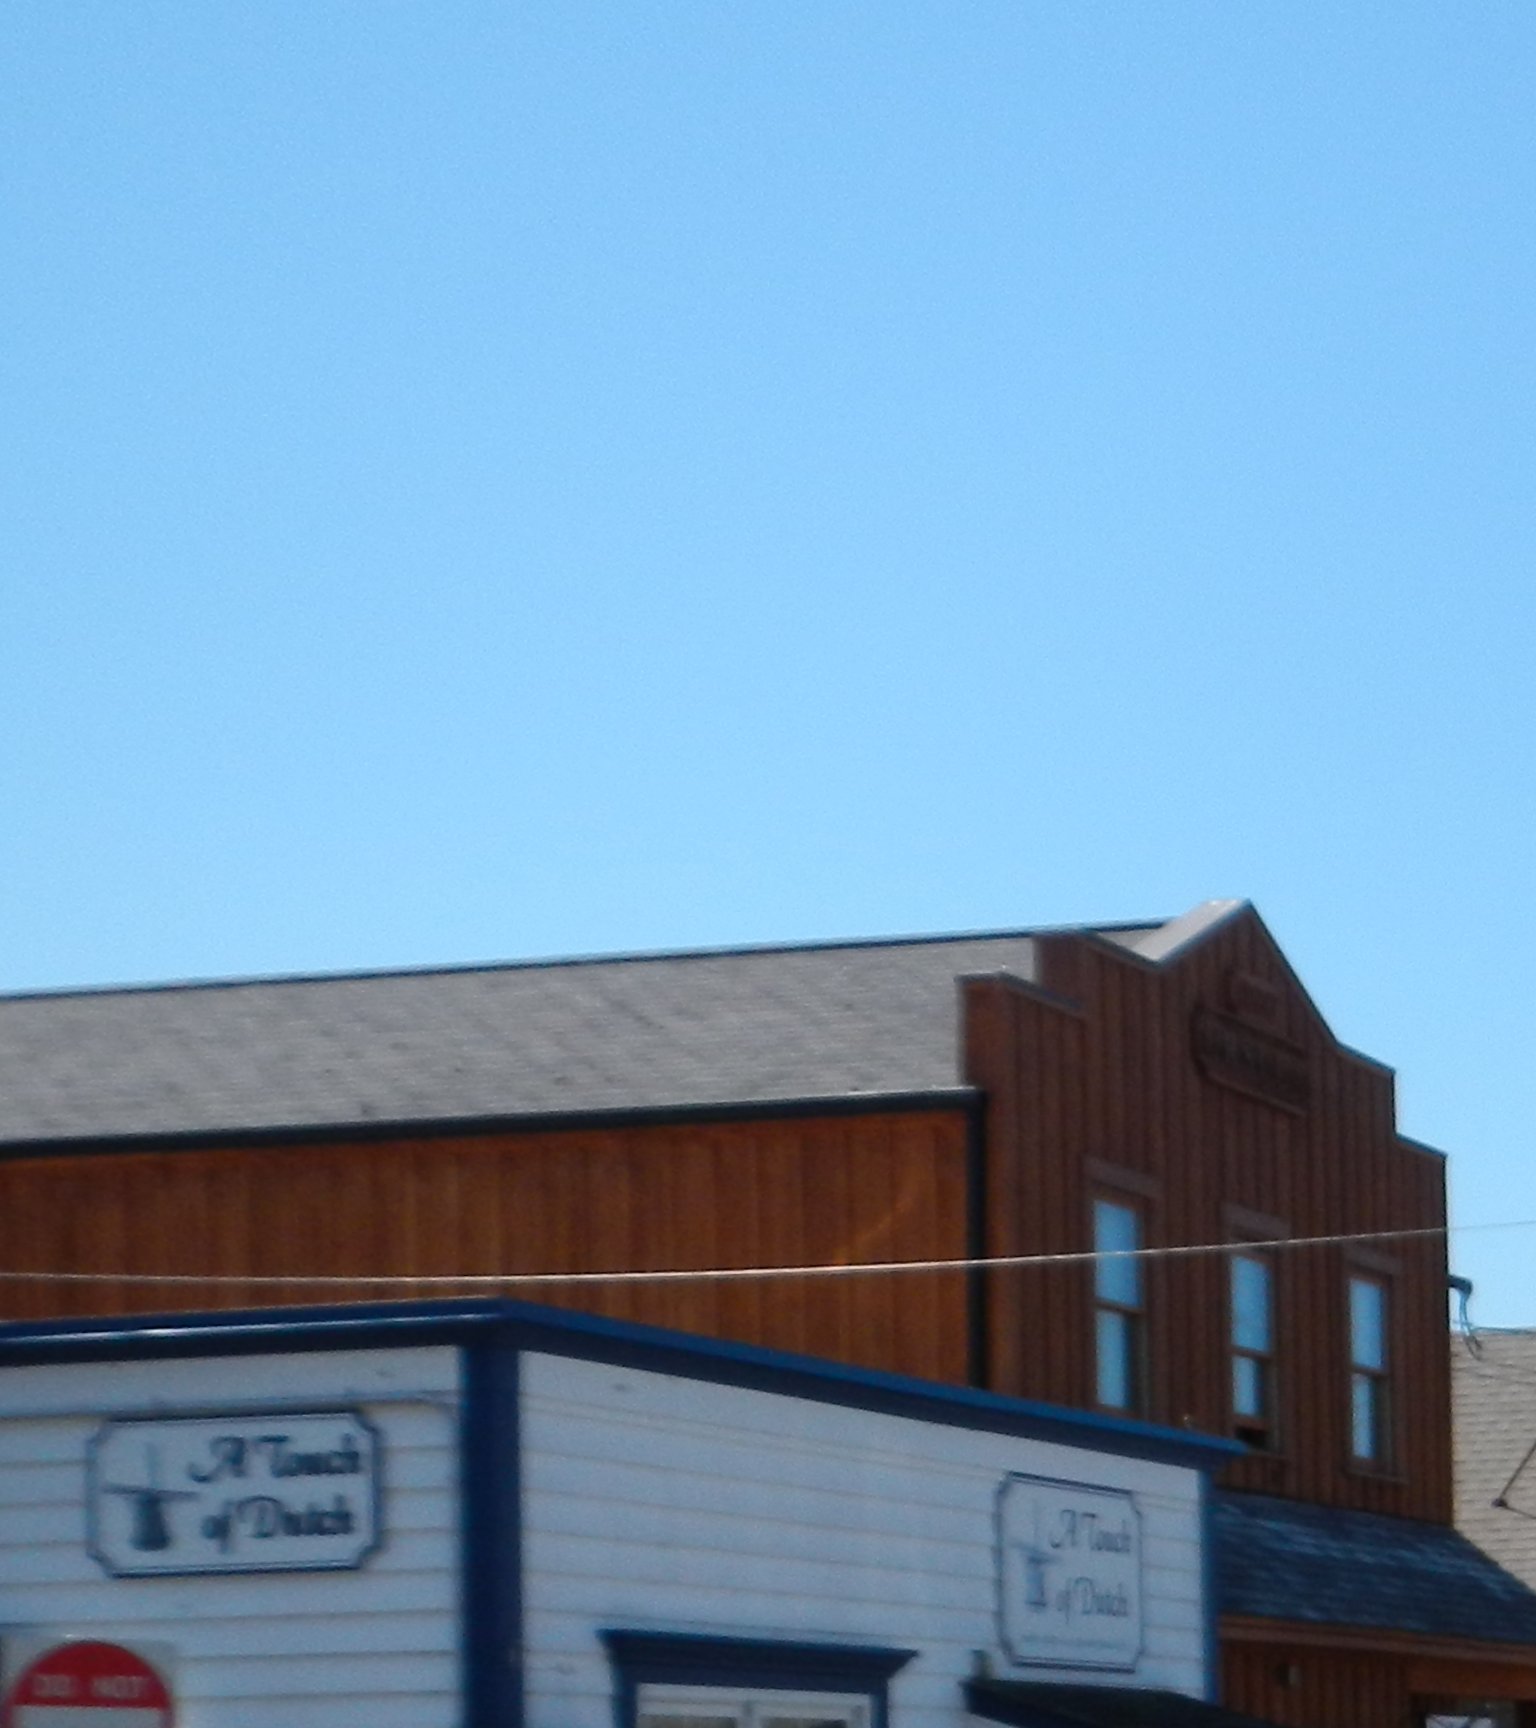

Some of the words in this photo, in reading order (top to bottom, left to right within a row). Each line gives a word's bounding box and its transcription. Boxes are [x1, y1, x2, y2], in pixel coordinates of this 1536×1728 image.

[188, 1436, 246, 1482] A
[252, 1434, 360, 1478] Touch
[202, 1500, 234, 1552] of
[236, 1494, 353, 1538] Dutch
[1080, 1511, 1131, 1553] Touch
[1074, 1576, 1129, 1617] Dutch
[34, 1674, 74, 1698] DO
[91, 1674, 147, 1700] NOT
